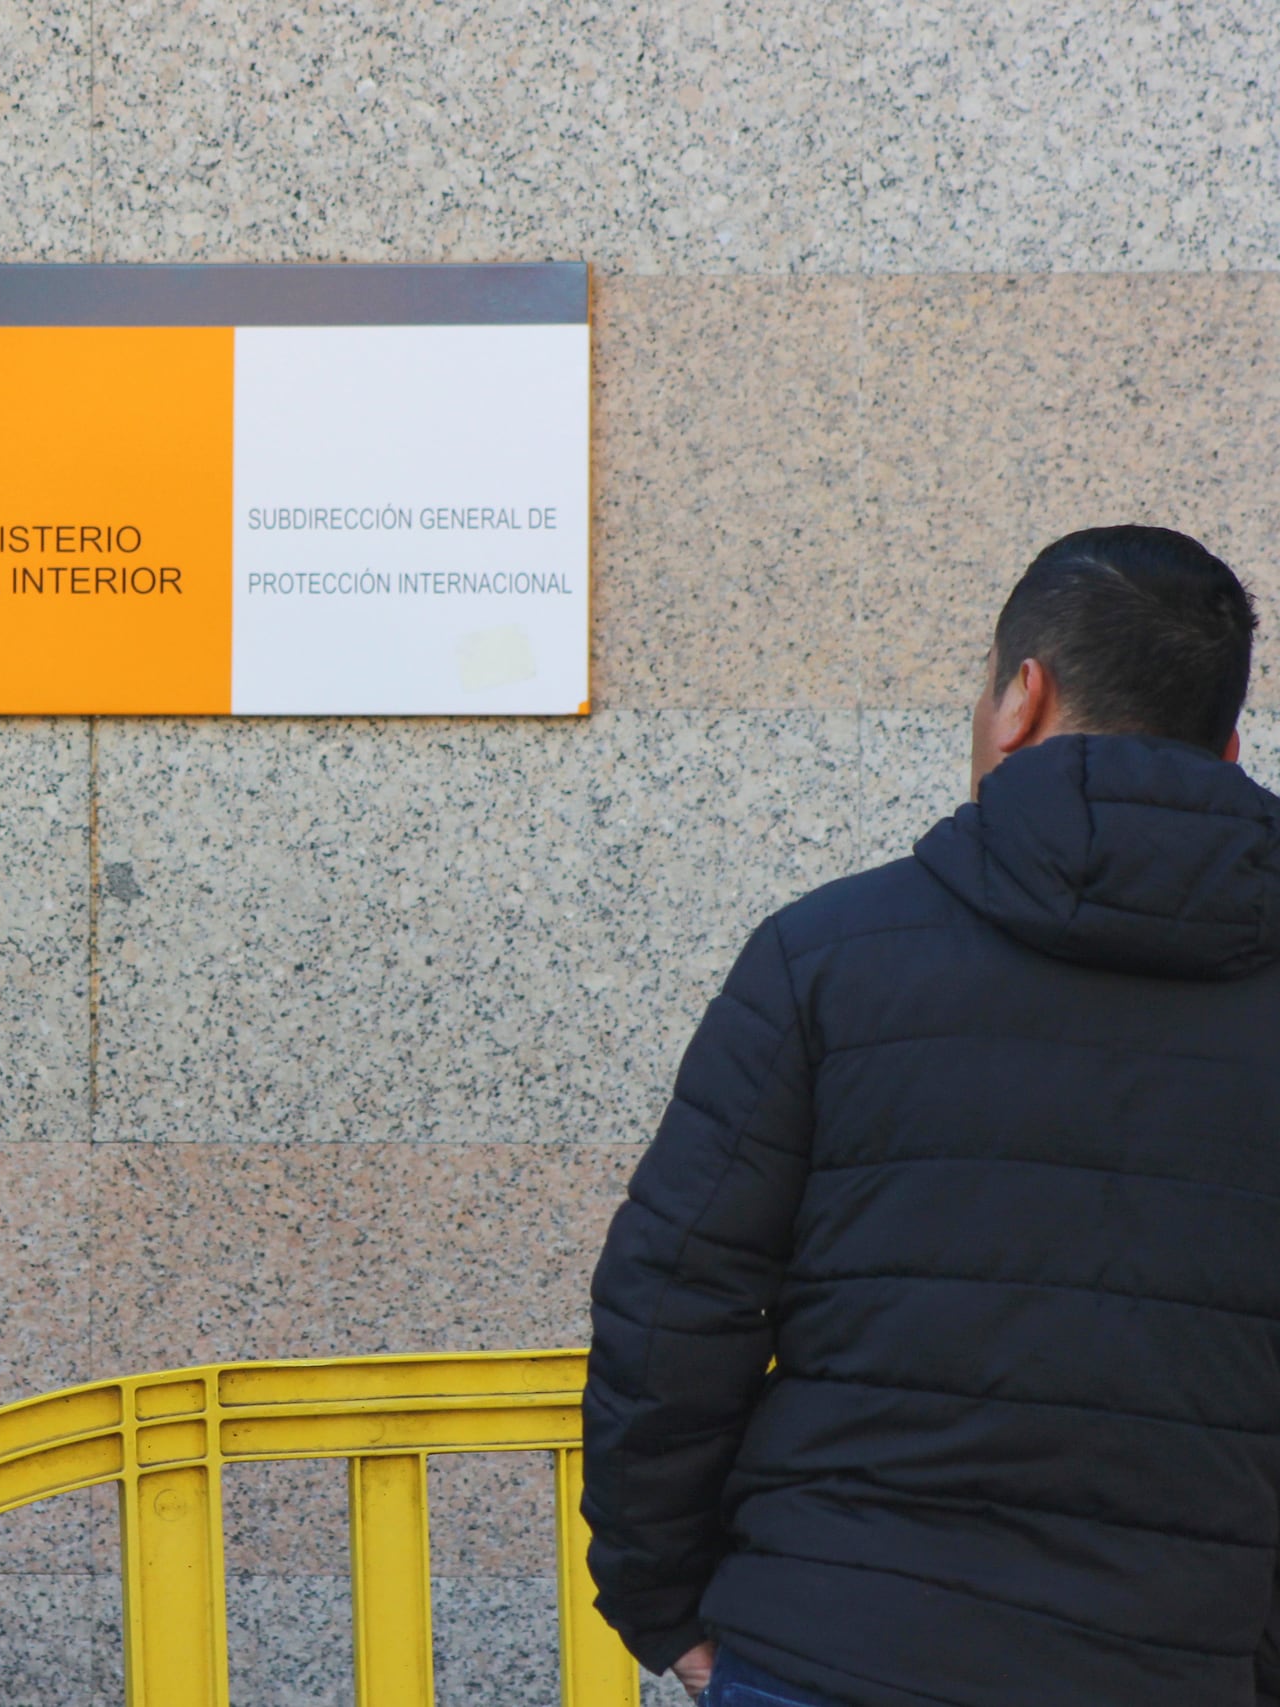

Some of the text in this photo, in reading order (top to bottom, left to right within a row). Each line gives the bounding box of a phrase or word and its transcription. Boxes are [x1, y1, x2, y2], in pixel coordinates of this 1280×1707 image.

[248, 502, 557, 530] SUBDIRECCIÓN GENERAL DE
[12, 567, 183, 595] INTERIOR
[248, 567, 573, 595] PROTECCIÓN INTERNACIONAL
